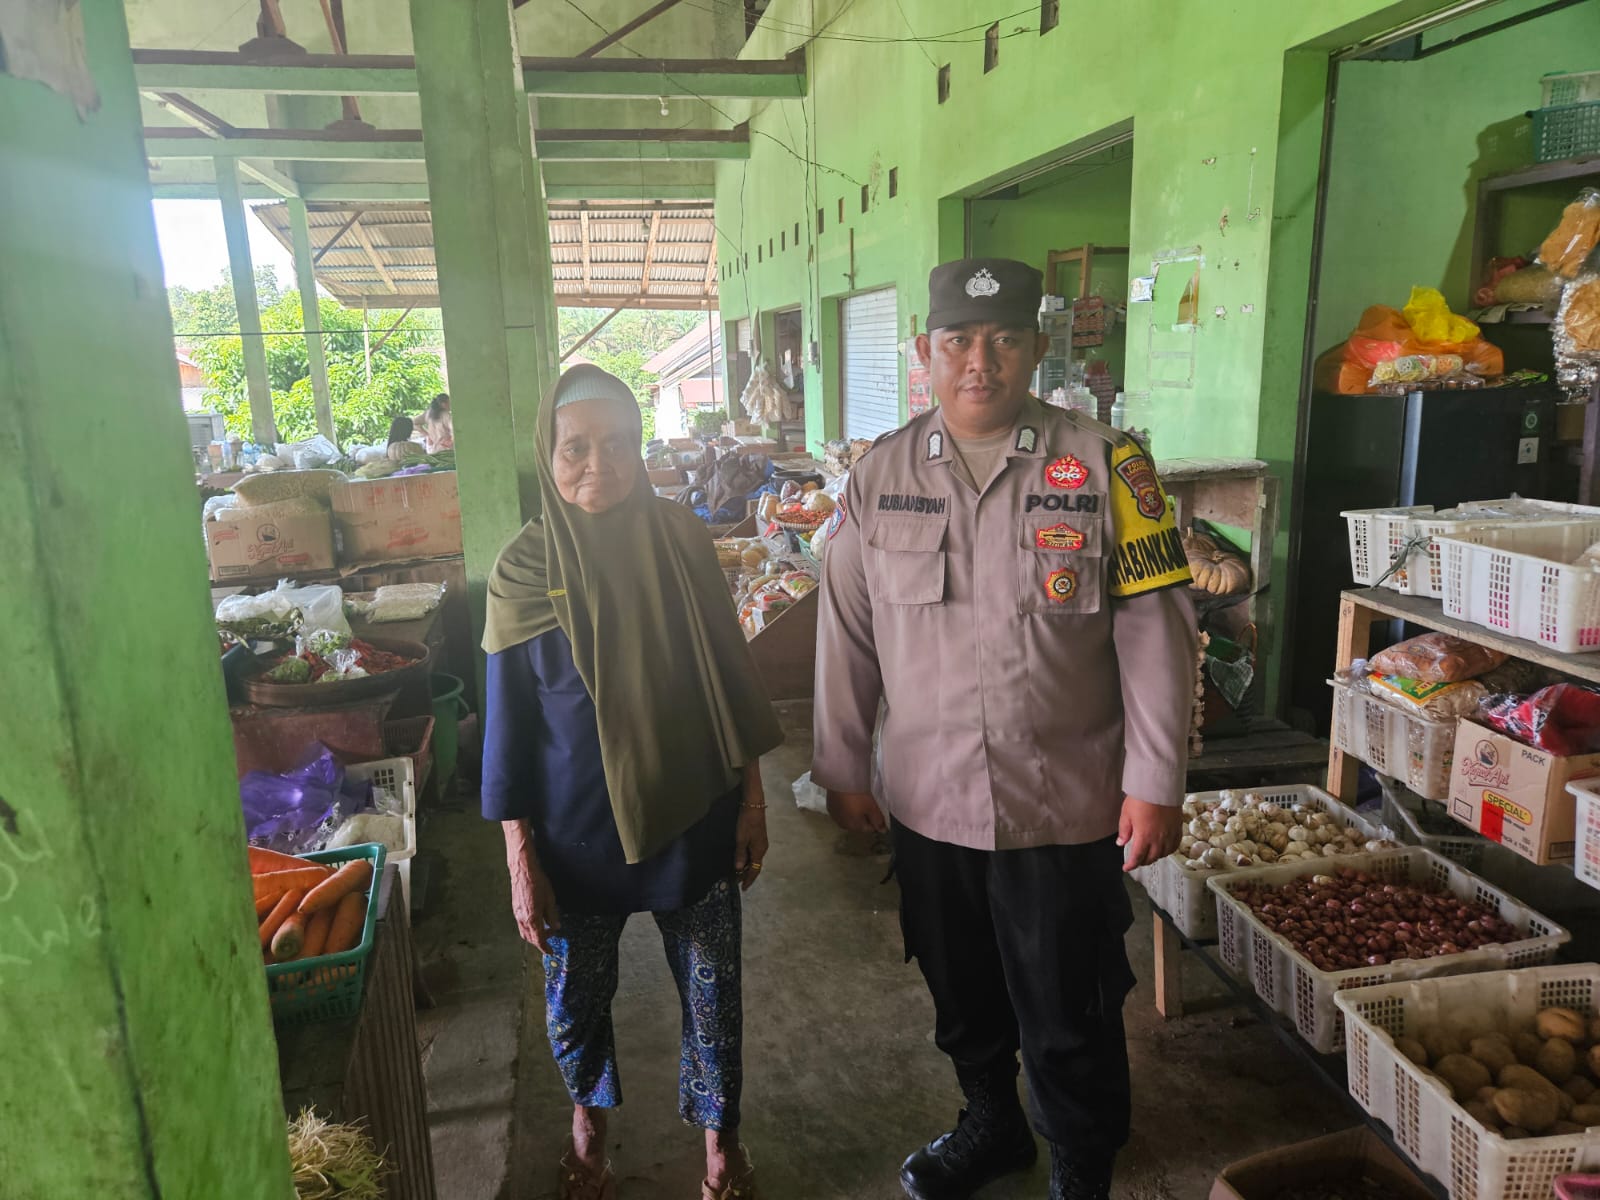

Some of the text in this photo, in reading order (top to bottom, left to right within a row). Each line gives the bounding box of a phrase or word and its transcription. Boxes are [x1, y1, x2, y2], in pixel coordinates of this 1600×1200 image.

[878, 494, 946, 514] RUBIANSYAH
[1025, 494, 1099, 513] POLRI
[1521, 749, 1545, 766] PACK
[1487, 793, 1526, 820] SPECIAL
